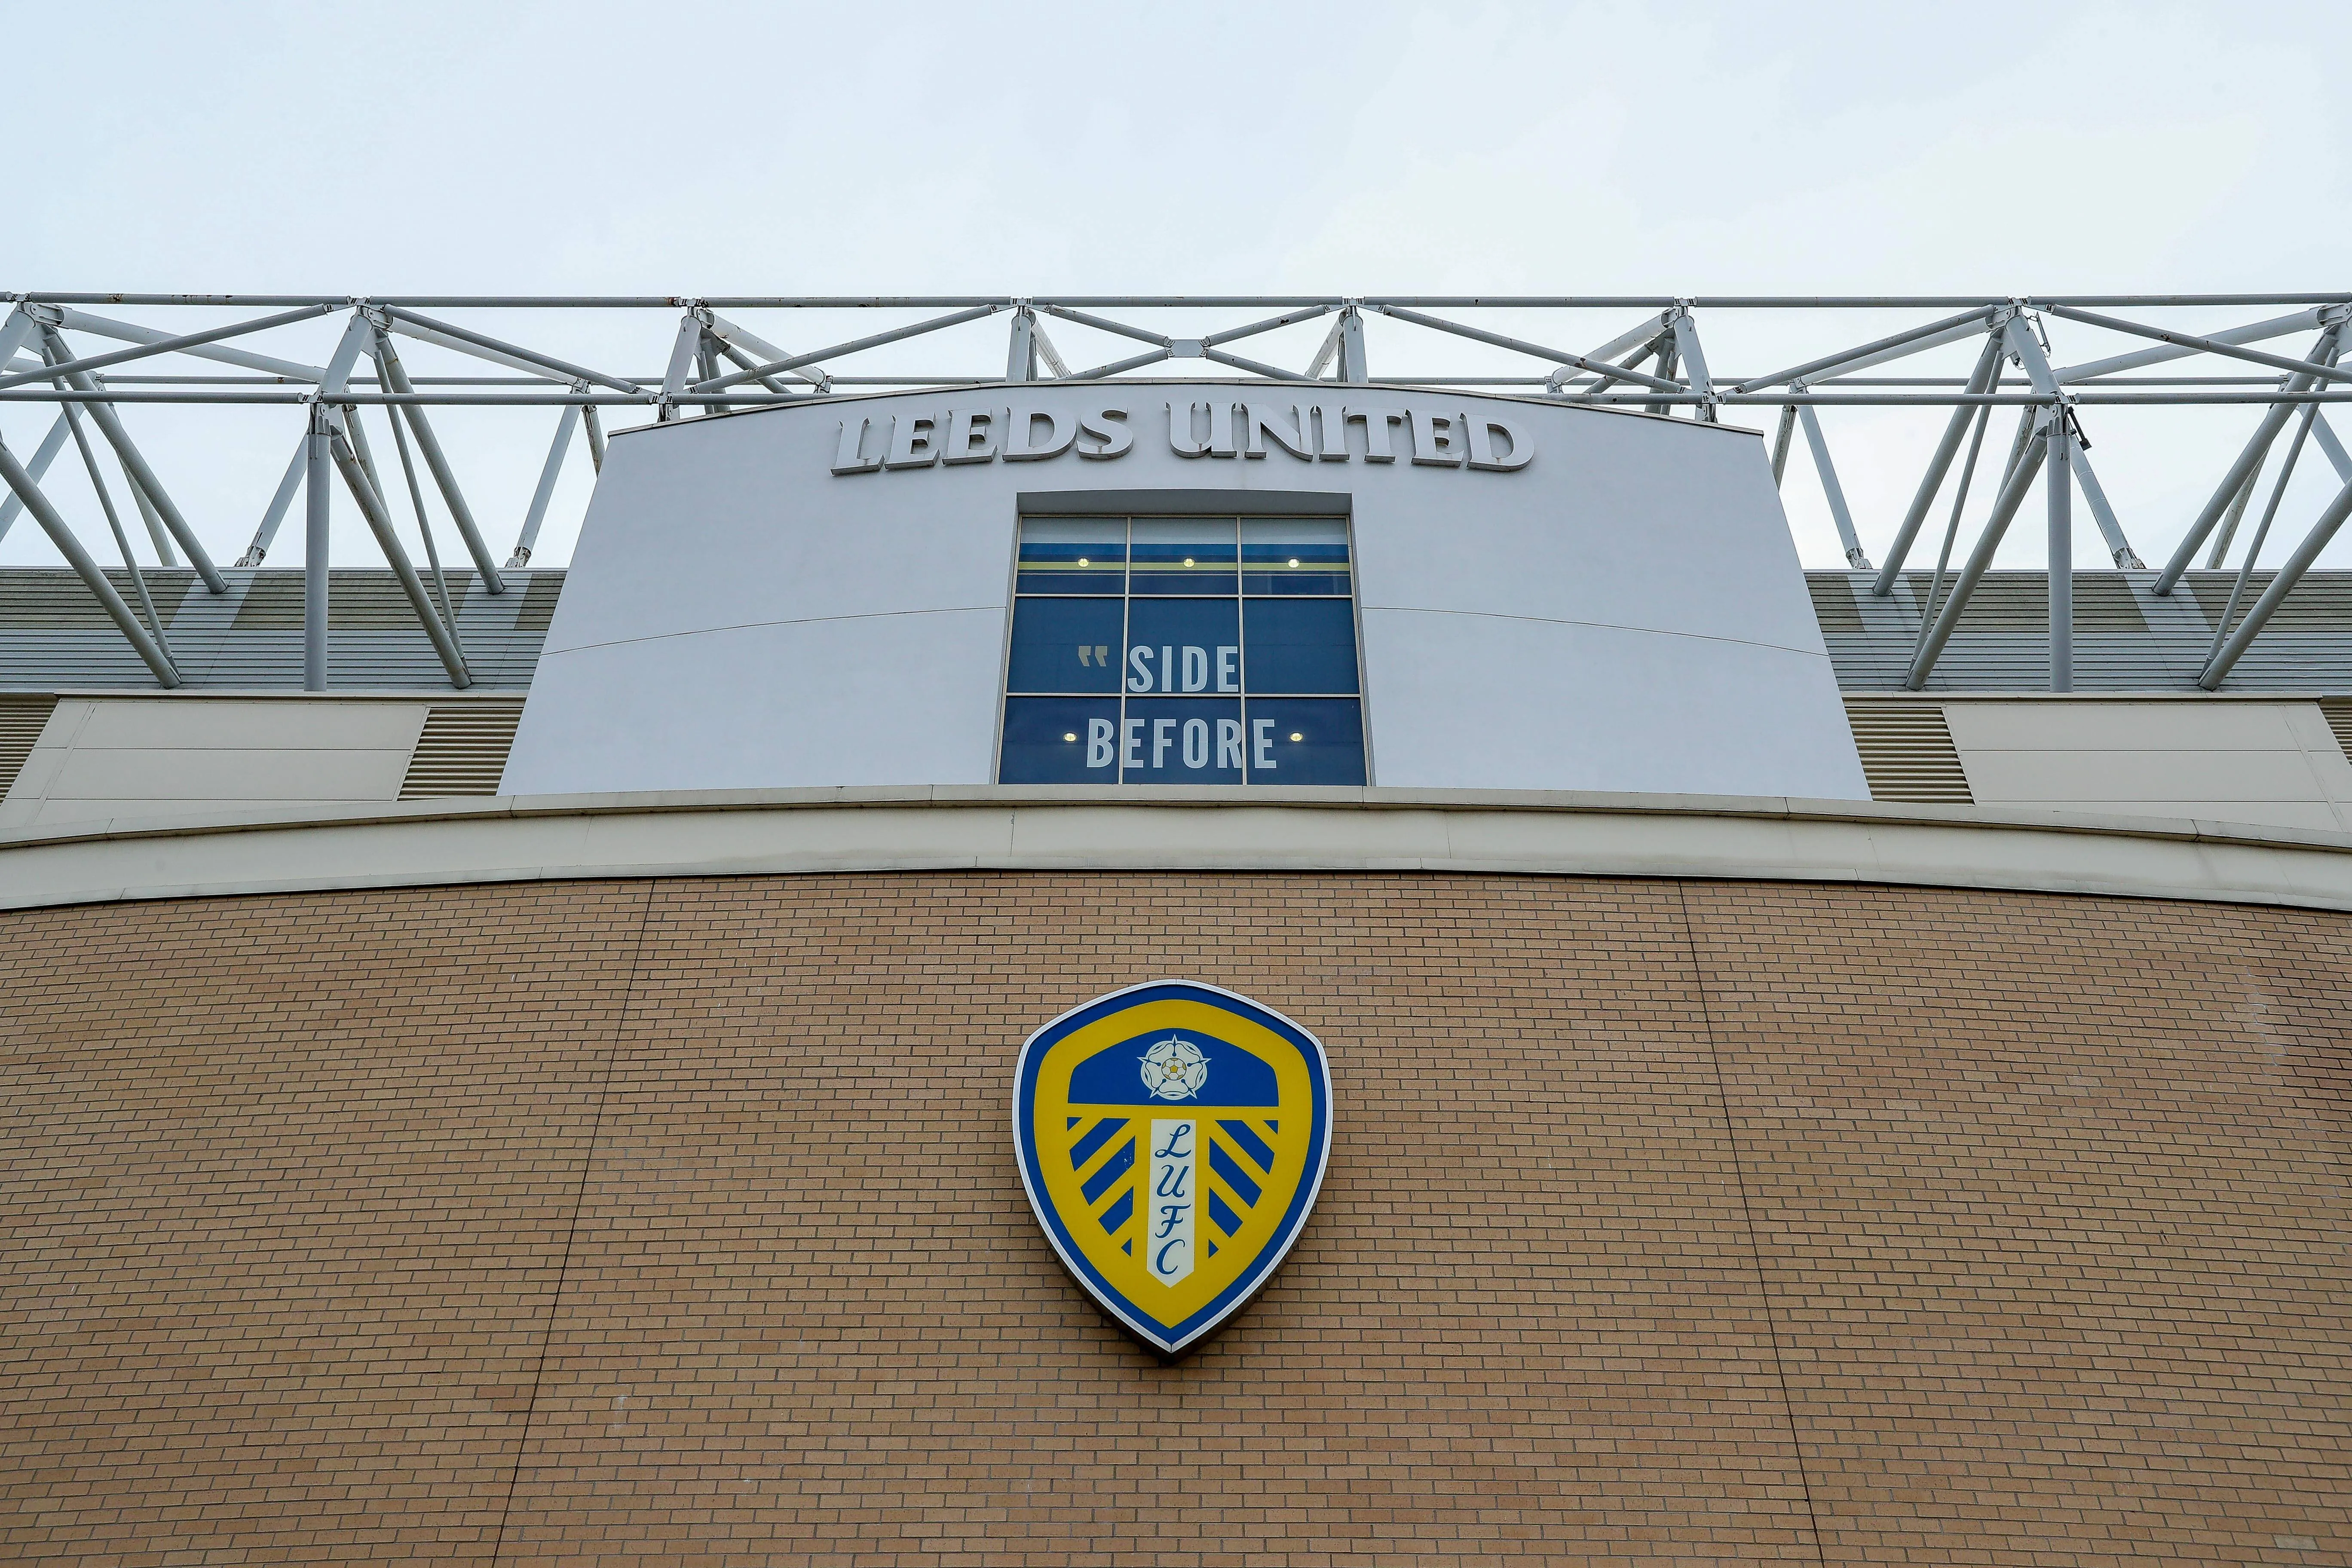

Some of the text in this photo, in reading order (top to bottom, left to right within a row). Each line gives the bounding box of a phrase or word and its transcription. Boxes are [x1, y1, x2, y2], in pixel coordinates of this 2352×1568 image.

[830, 401, 1535, 475] LEEDS UNITED
[1086, 718, 1277, 769] BEFORE
[1155, 1124, 1191, 1275] LUFC
